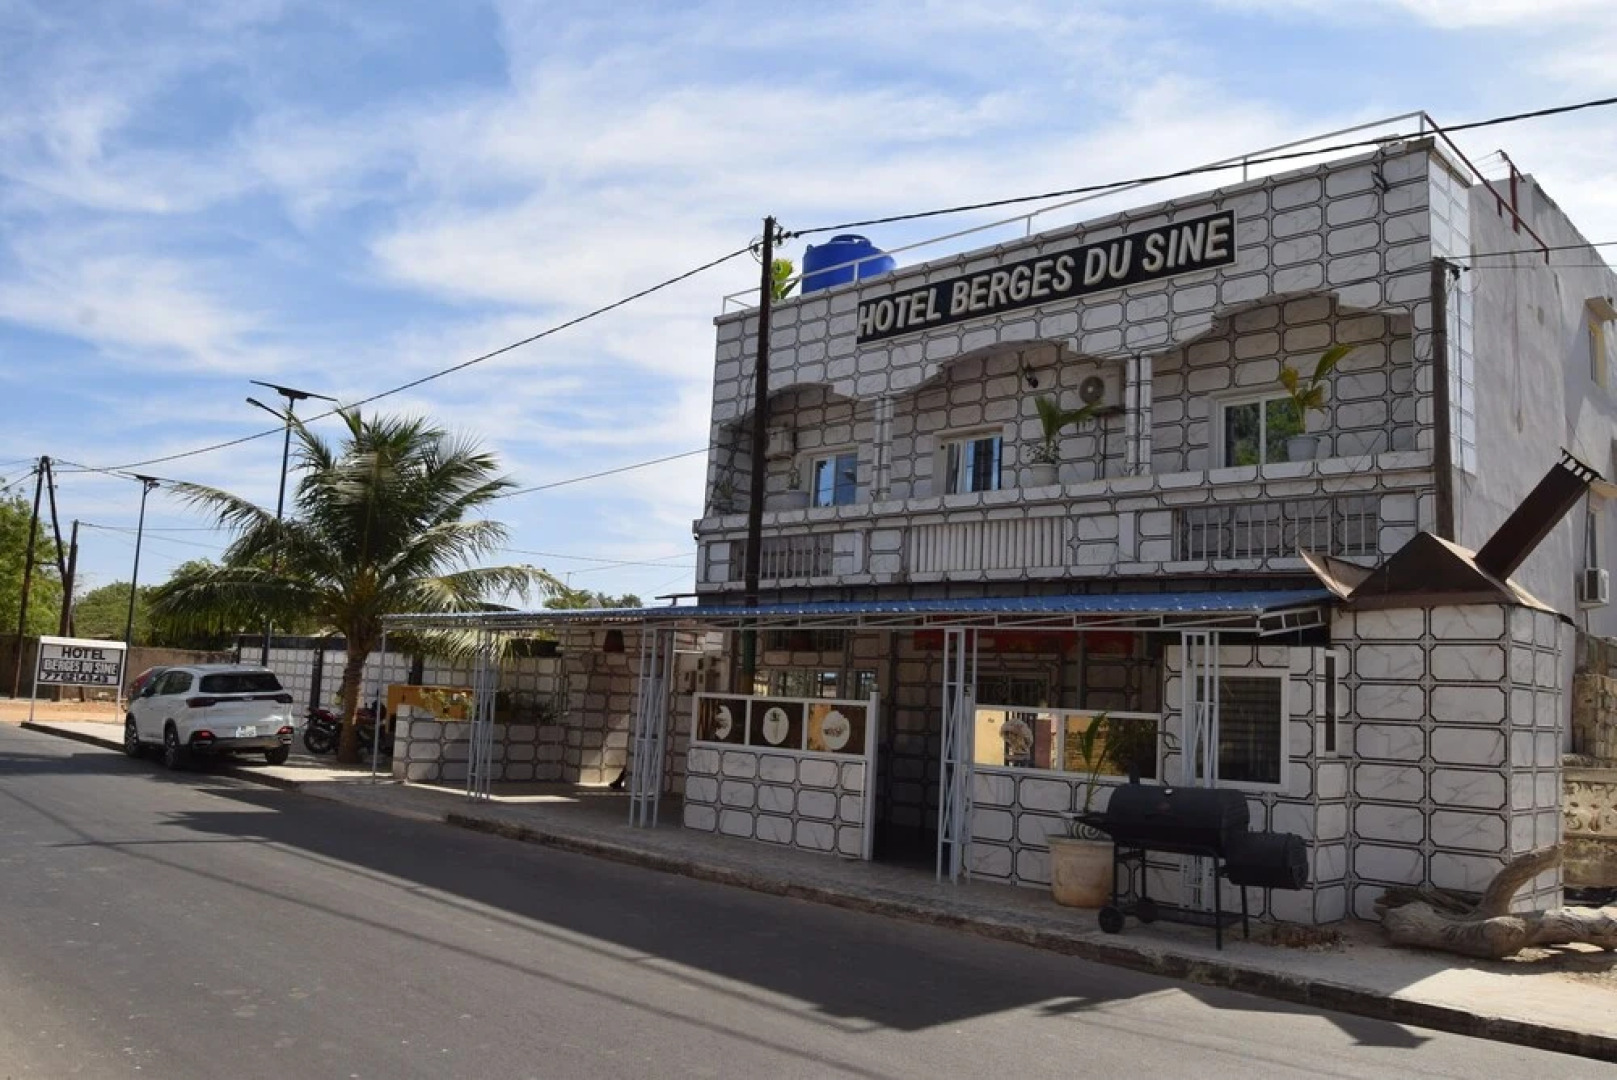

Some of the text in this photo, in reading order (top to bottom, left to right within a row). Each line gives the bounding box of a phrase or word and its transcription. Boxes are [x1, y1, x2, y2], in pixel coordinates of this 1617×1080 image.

[857, 217, 1231, 338] HOTEL BERGES DU SINE
[61, 646, 106, 660] HOTEL
[43, 659, 80, 672] BERGES
